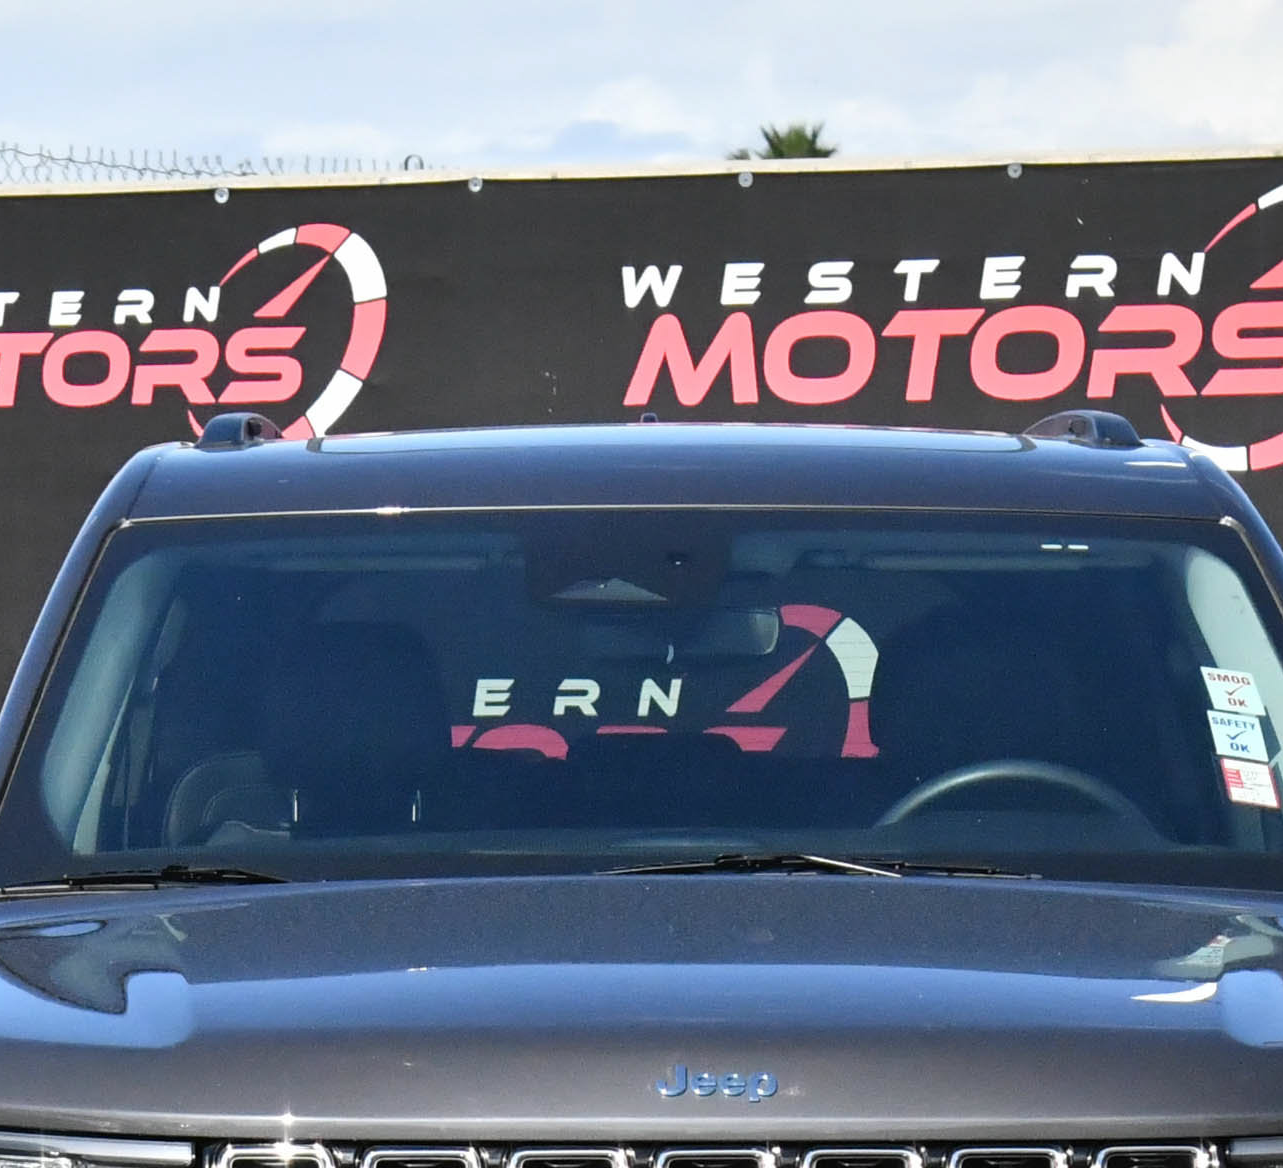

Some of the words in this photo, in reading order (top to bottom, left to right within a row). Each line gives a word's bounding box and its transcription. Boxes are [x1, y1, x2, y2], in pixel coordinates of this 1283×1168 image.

[622, 251, 1205, 309] WESTERN
[1206, 671, 1252, 686] SMOG
[1227, 697, 1248, 707] OK
[1211, 716, 1256, 731] SAFETY
[1230, 742, 1250, 753] OK
[654, 1063, 779, 1103] Jeep
